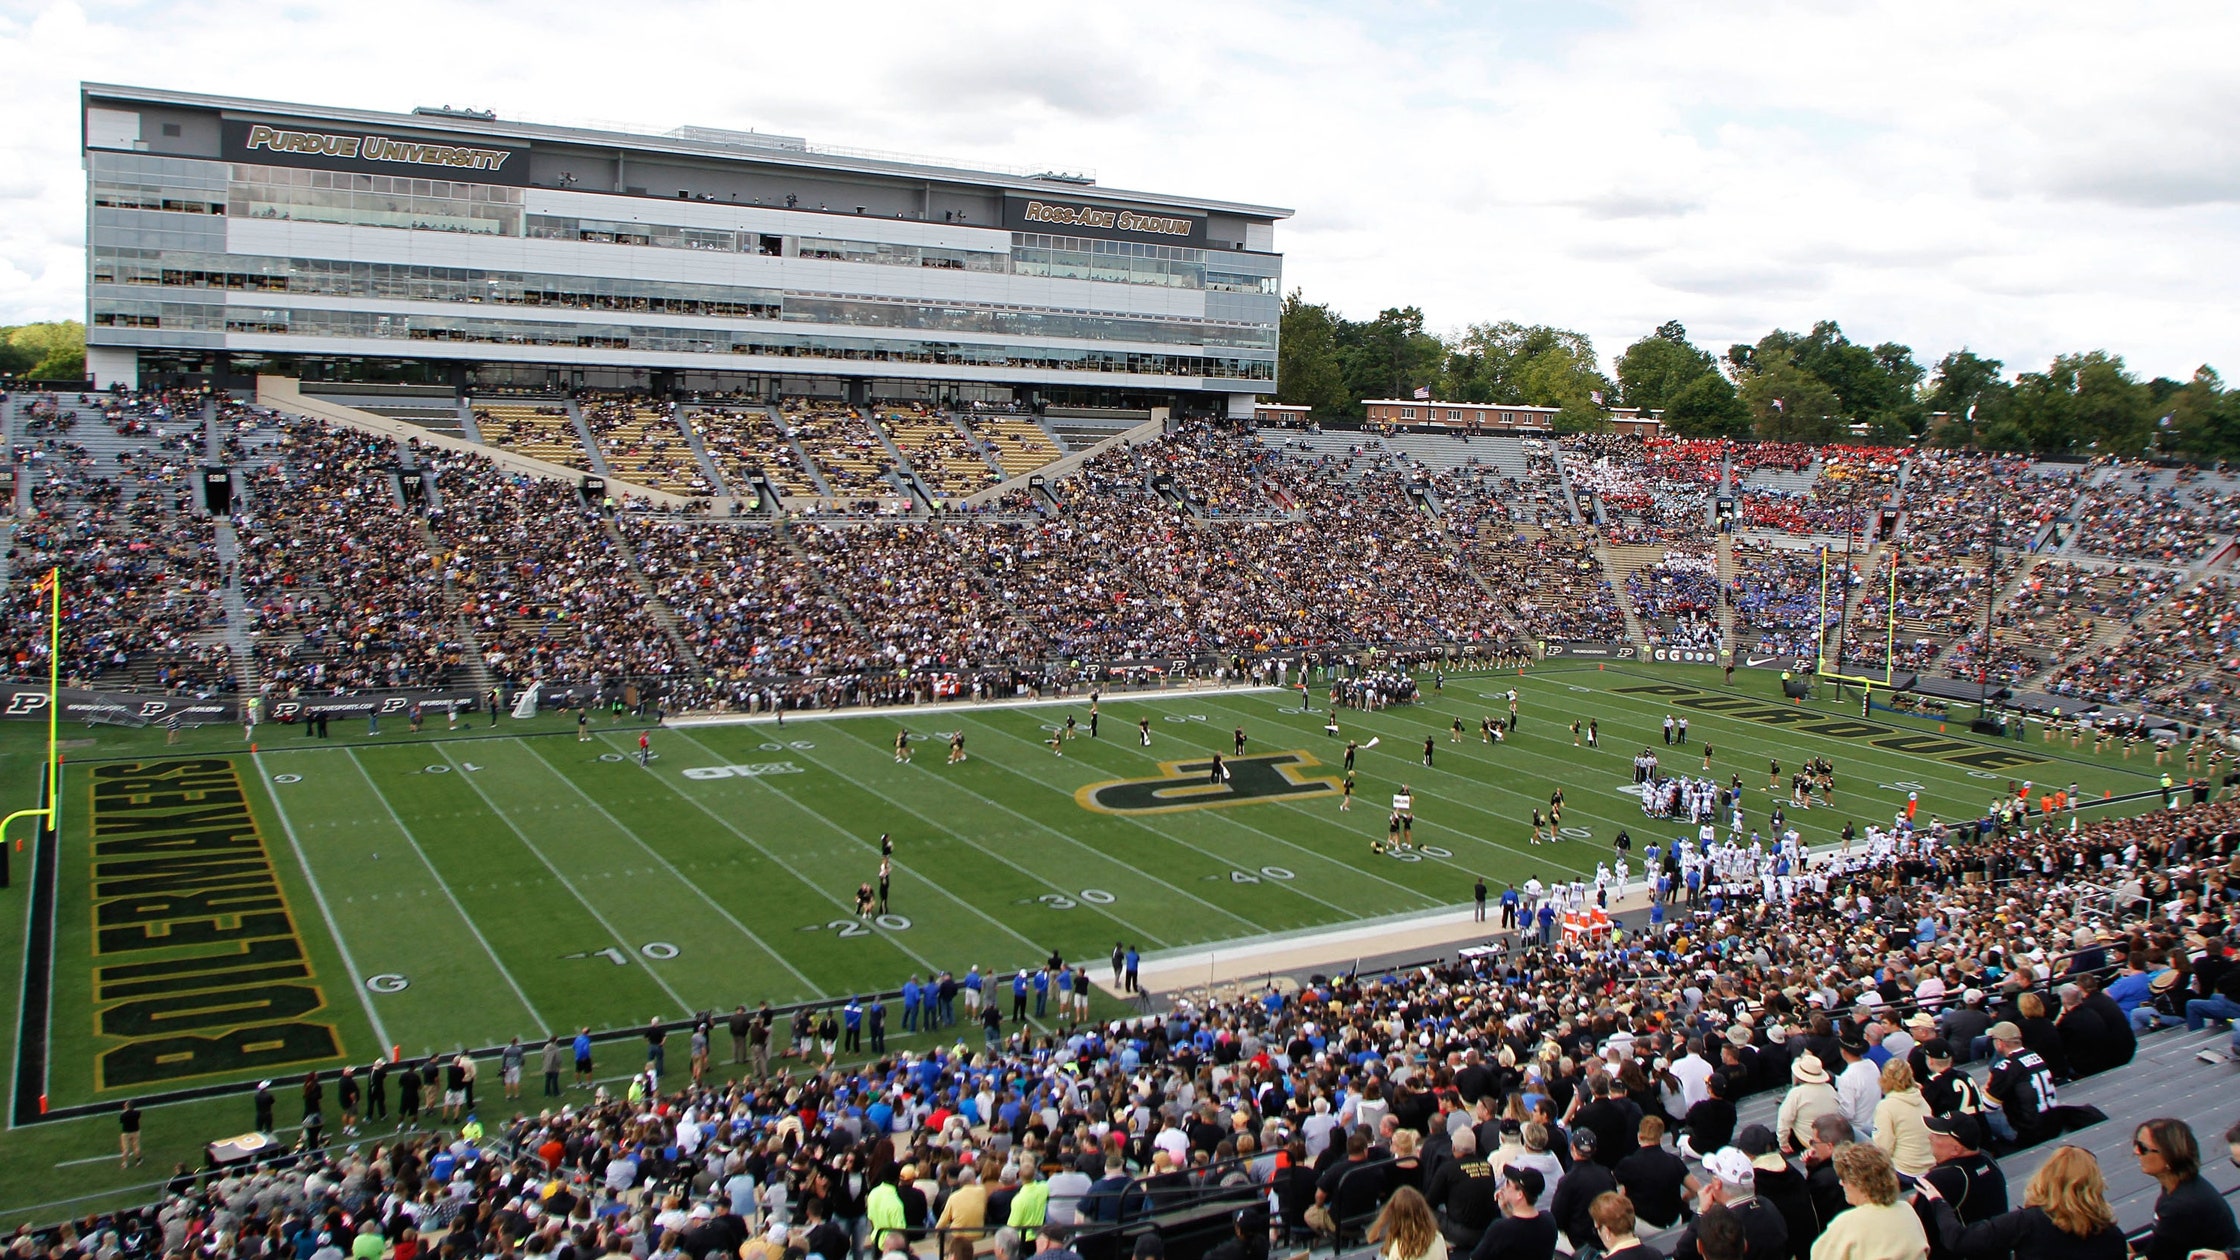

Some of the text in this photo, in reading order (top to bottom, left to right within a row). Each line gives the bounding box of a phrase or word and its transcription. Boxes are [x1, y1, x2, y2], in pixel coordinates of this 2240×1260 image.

[247, 125, 511, 171] PURDUE UNIVERSITY
[1118, 211, 1192, 236] STADIUM
[1546, 645, 1563, 656] P
[1616, 647, 1634, 658] P
[1654, 649, 1680, 662] G G
[1171, 660, 1187, 672] P
[5, 692, 50, 715] P
[140, 701, 168, 717] P
[381, 697, 408, 713] P
[1608, 685, 2056, 771] PURDUE
[1229, 865, 1296, 885] 40
[1037, 888, 1117, 910] 30
[90, 759, 347, 1092] BOILERMAKERS
[826, 914, 913, 939] 20
[593, 940, 681, 967] 10
[365, 972, 410, 994] G
[2030, 1069, 2058, 1113] 15
